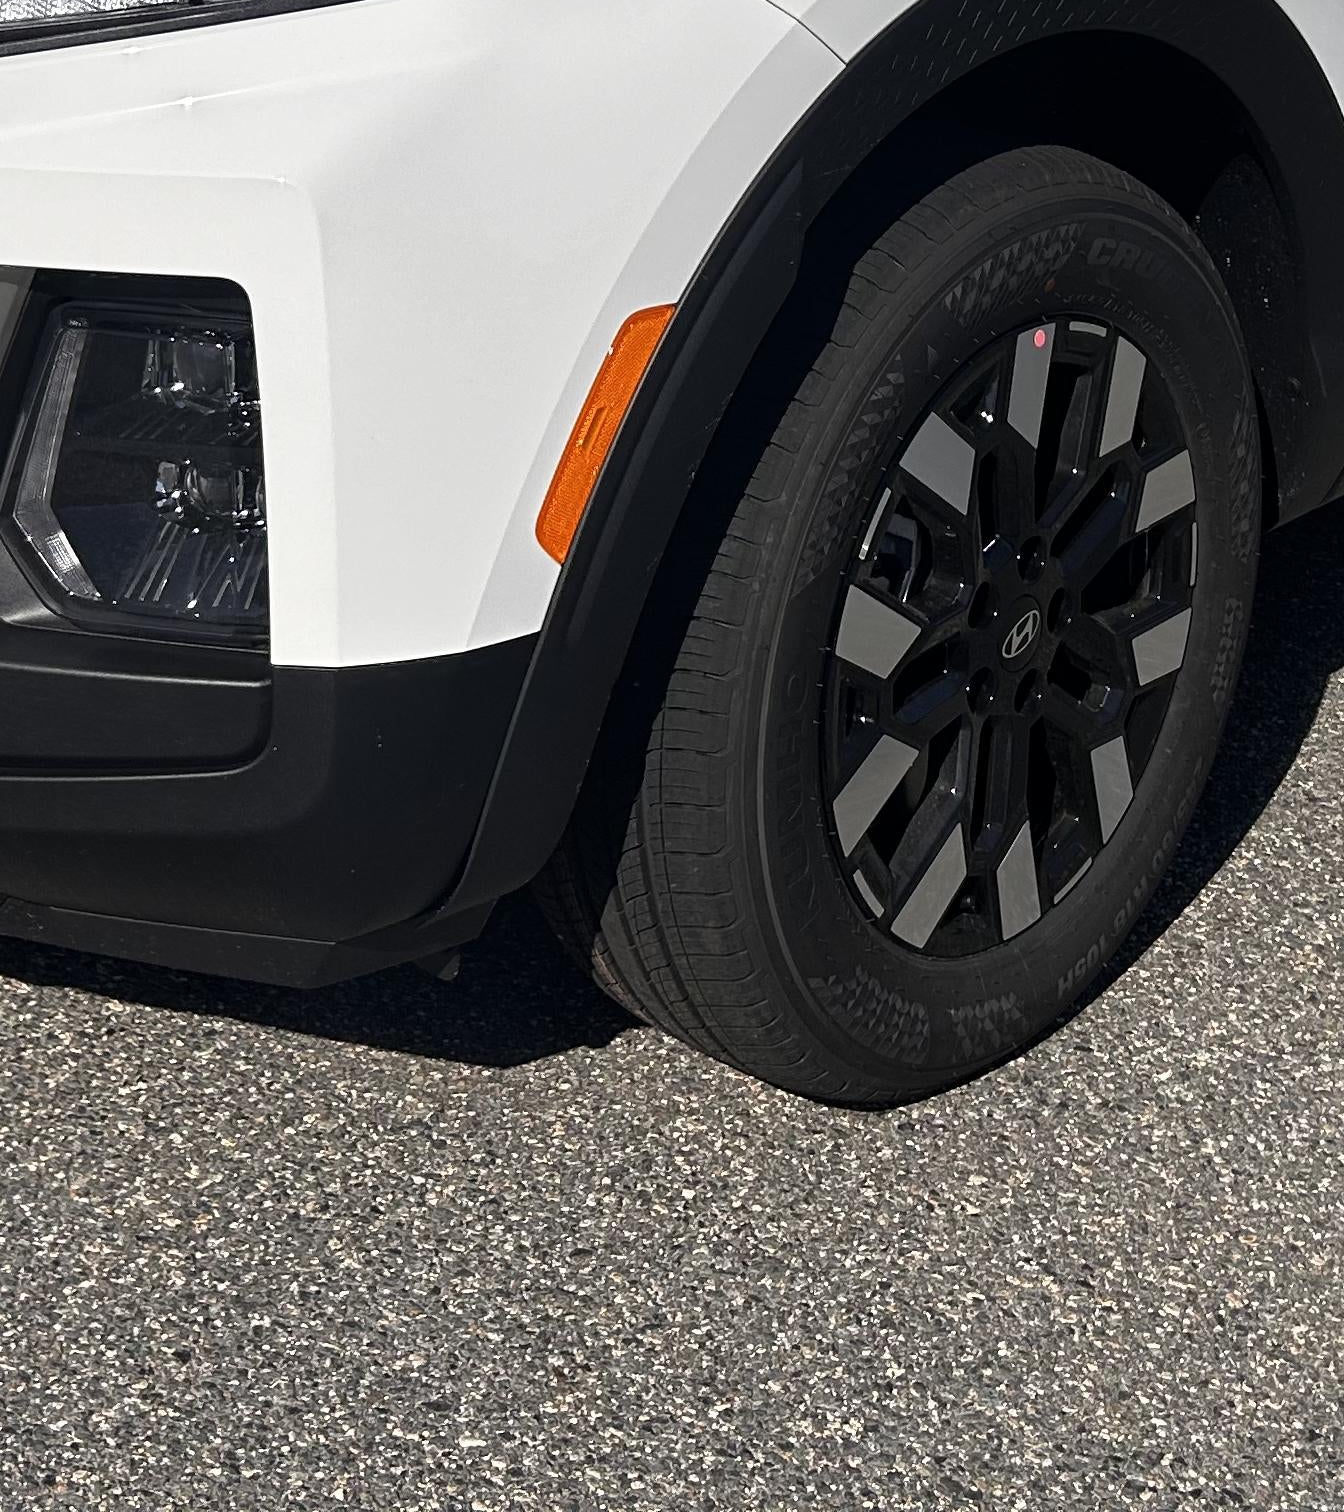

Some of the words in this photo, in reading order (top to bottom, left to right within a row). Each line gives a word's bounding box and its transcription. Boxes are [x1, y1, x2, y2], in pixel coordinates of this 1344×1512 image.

[776, 669, 822, 934] KUMHO
[1112, 875, 1149, 931] R18
[1057, 933, 1107, 997] 105H
